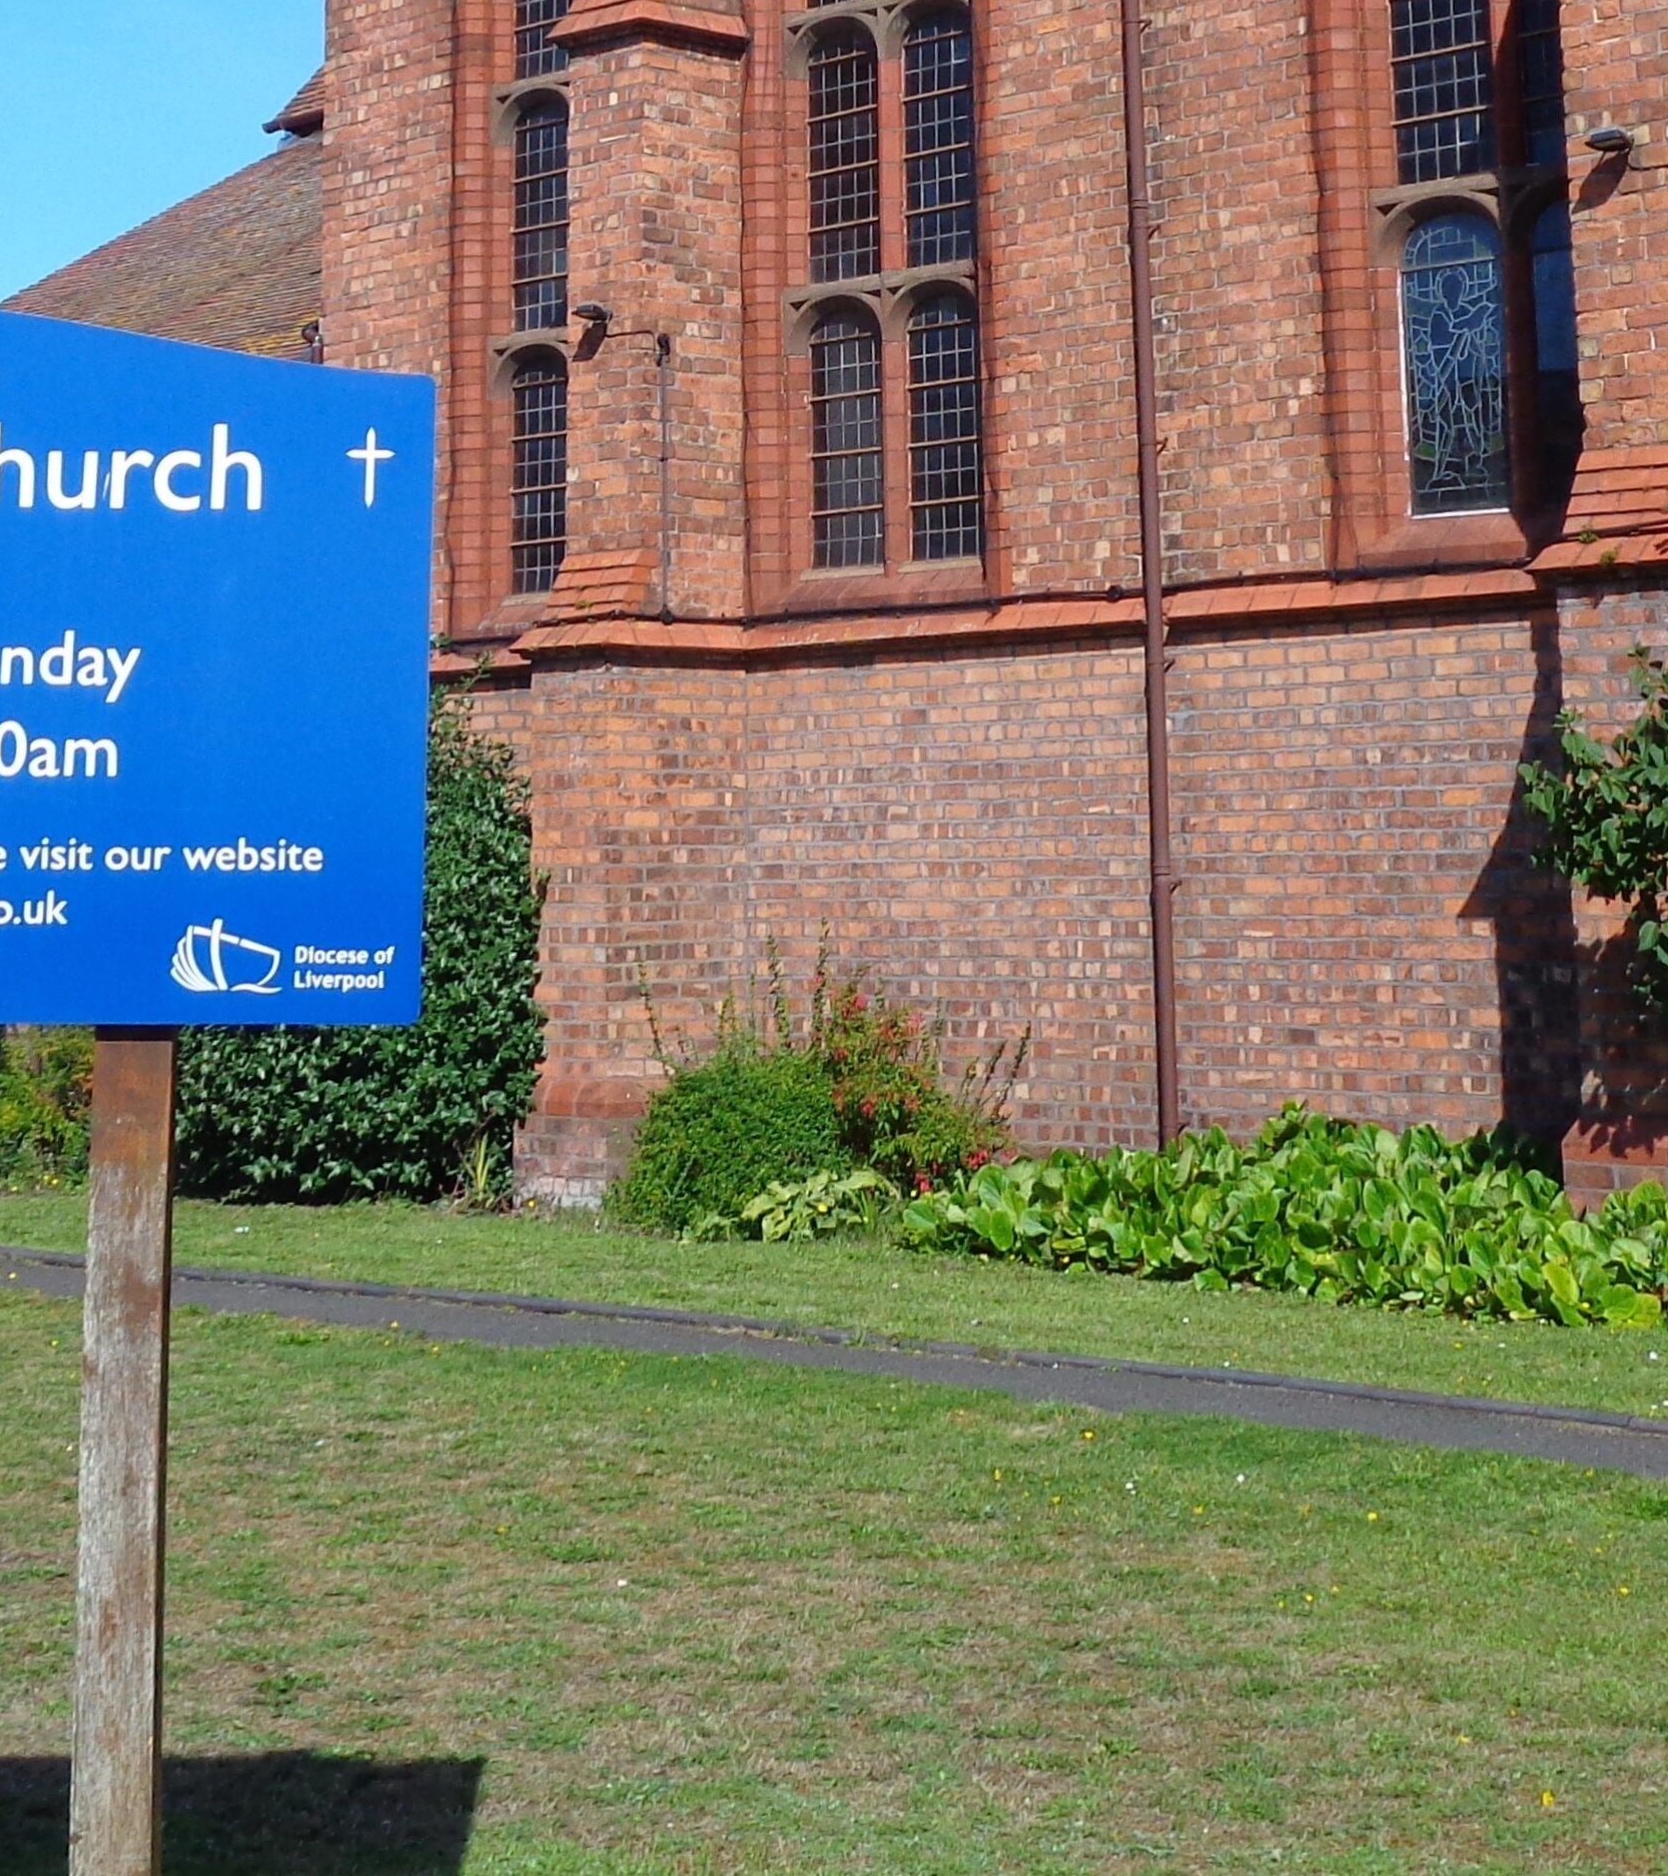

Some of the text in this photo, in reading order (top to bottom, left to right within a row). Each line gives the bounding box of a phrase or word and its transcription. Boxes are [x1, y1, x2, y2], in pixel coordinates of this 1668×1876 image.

[20, 838, 92, 870] visit
[105, 847, 171, 870] our
[183, 838, 323, 871] website
[295, 946, 394, 964] Diocese of
[294, 971, 383, 992] Liverpool
